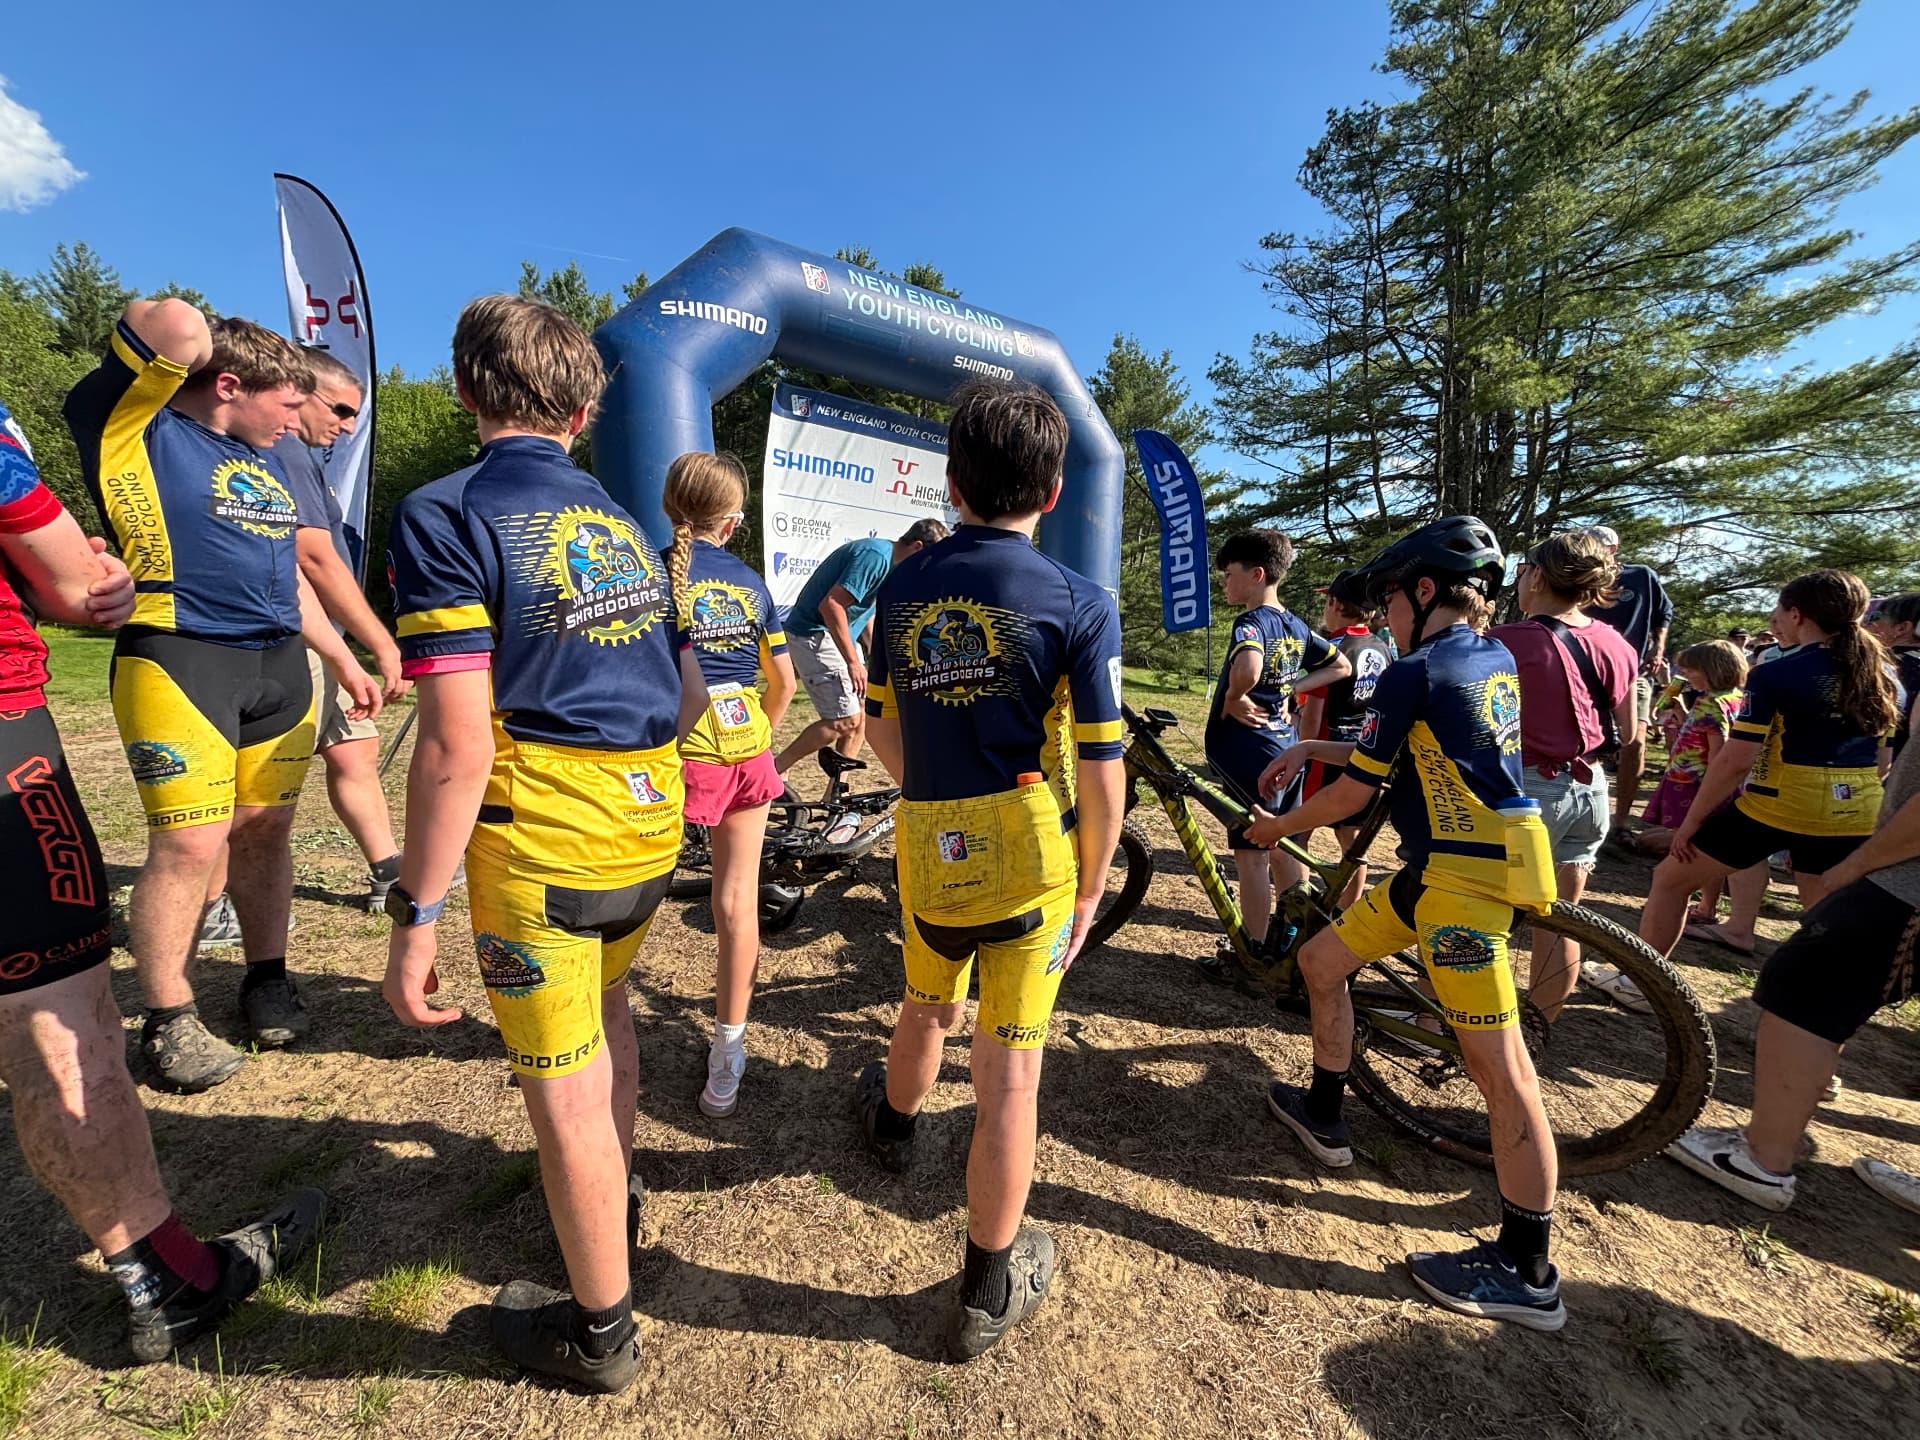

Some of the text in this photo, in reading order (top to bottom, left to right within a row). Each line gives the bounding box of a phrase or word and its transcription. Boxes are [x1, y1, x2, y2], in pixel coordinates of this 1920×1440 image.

[660, 300, 768, 335] SHIMANO
[848, 269, 900, 299] NEW
[905, 288, 1005, 331] ENGLAND
[842, 288, 1014, 357] YOUTH CYCLING
[953, 355, 1014, 381] SHIMANO
[816, 405, 841, 418] NEW
[842, 411, 887, 429] ENGLAND
[890, 423, 919, 438] YOUTH
[773, 448, 875, 484] SHIMANO
[122, 472, 166, 574] YOUTH CYCLING
[791, 517, 832, 529] COLONIAL
[791, 525, 831, 537] BICYCLE
[1153, 460, 1197, 625] SHIMANO
[565, 588, 660, 630] SHREDDERS
[572, 578, 650, 609] Shawsheen
[911, 667, 996, 690] SHREDDERS
[916, 657, 988, 676] Shawsheen
[1428, 778, 1455, 833] CYCLING
[6, 754, 96, 907] VERGE
